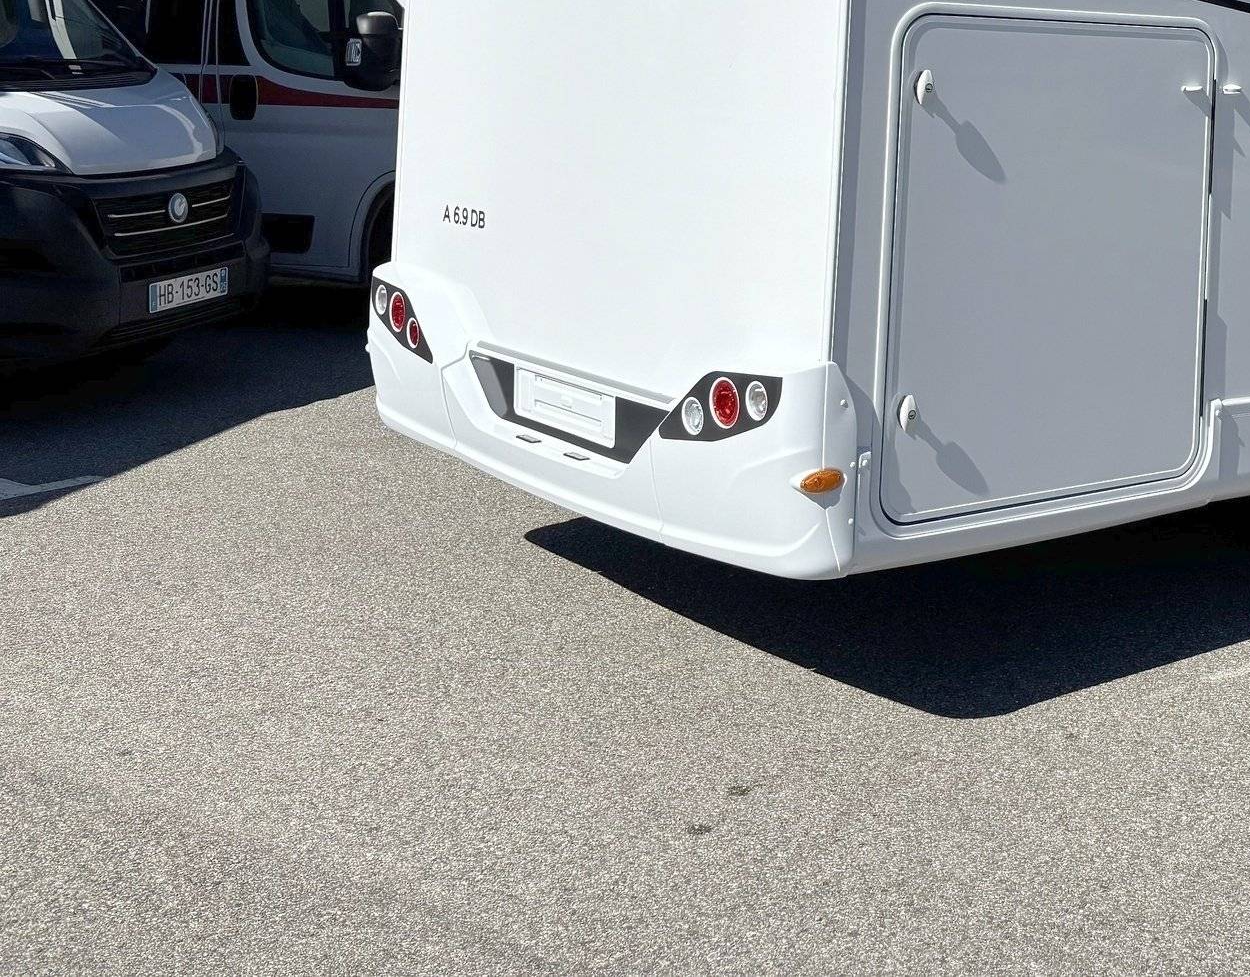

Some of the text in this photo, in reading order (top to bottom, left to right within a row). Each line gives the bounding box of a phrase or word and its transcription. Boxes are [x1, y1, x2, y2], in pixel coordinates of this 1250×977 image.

[442, 204, 486, 229] A 6.9 DB
[158, 273, 219, 306] HB-153-GS
